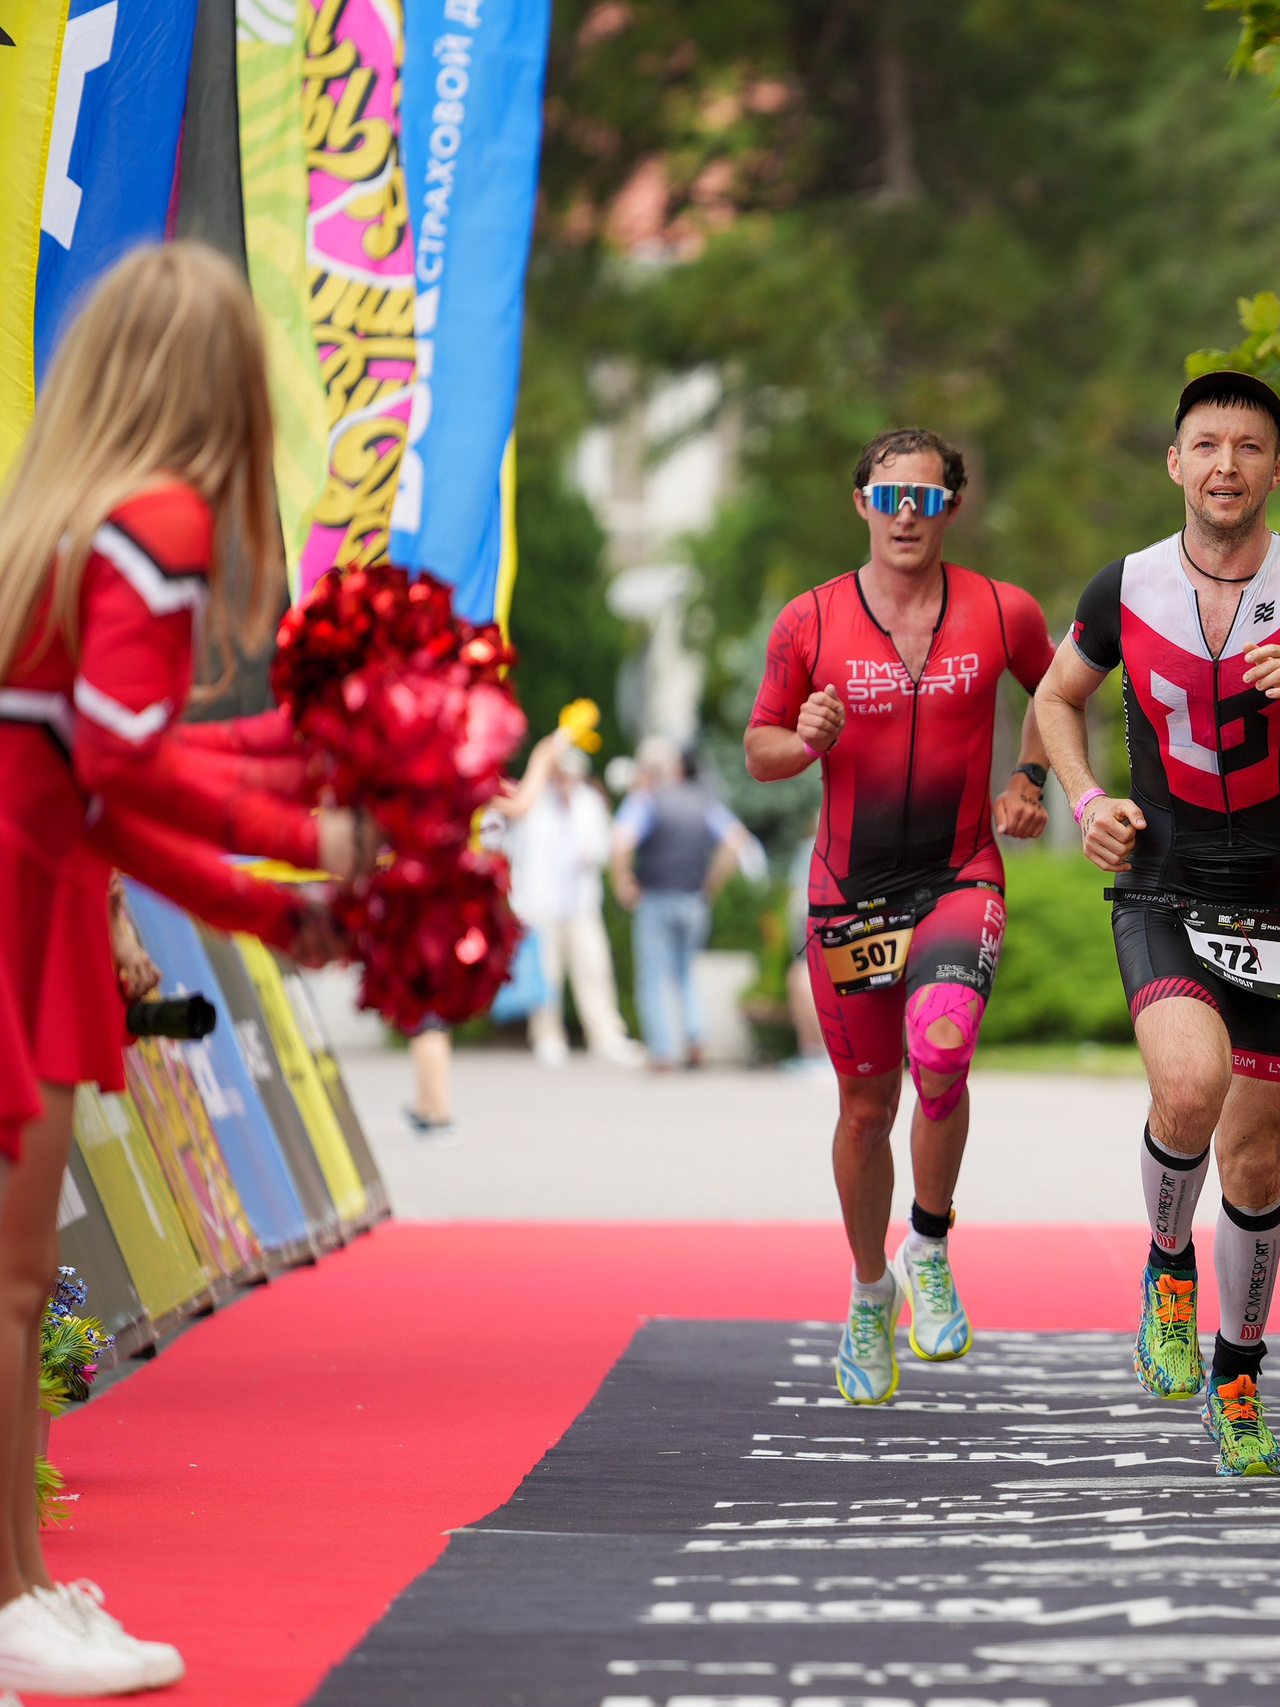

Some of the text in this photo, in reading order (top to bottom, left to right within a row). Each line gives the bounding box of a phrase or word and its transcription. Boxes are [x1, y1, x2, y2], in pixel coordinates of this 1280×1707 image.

[414, 35, 474, 283] СТРАХОВОЙ
[846, 653, 979, 679] TIME TO
[846, 672, 979, 700] SPORT
[850, 702, 892, 715] TEAM
[851, 939, 897, 971] 507
[1207, 941, 1259, 975] 272
[1223, 971, 1254, 989] ANATOLIY
[1156, 1173, 1176, 1233] COMPRESSPORT
[1244, 1241, 1270, 1323] COMPRESSPORT
[750, 1450, 1048, 1461] IRON
[702, 1510, 1035, 1528] IRON
[650, 1597, 1042, 1621] IRON
